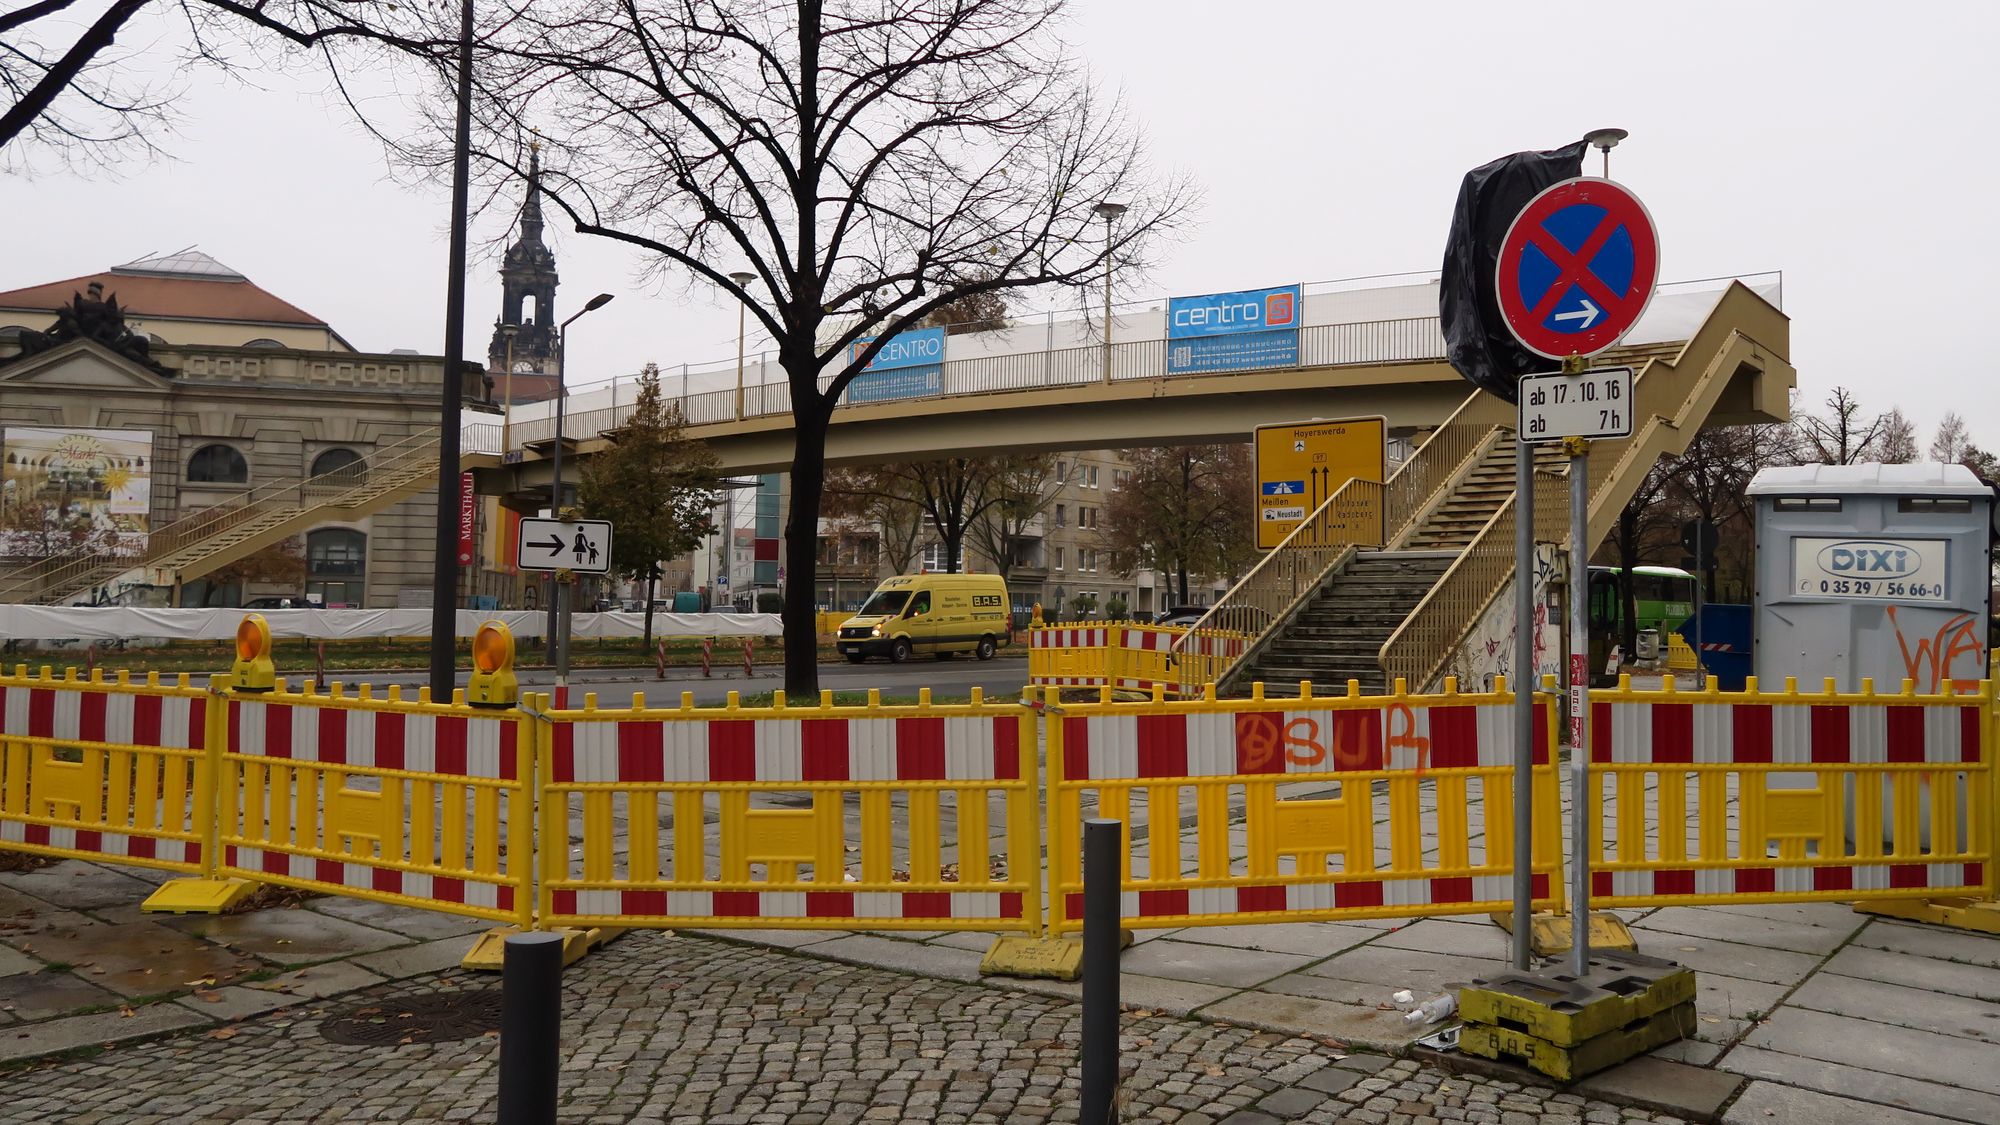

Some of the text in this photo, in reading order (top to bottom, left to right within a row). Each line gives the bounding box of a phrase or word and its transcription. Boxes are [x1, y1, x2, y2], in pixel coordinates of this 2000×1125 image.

[1175, 300, 1260, 327] centro
[879, 337, 940, 362] CENTRO
[1530, 387, 1545, 406] ab
[1605, 380, 1620, 400] 16
[1530, 409, 1620, 433] ab 7 h
[1294, 427, 1346, 438] Hoyerswerda
[1262, 498, 1289, 506] Meißen
[1277, 510, 1303, 518] Neustadt
[1820, 580, 1829, 593] 0
[1833, 580, 1850, 594] 35
[1854, 581, 1872, 595] 29
[1887, 582, 1905, 596] 56
[1909, 582, 1942, 597] 66-0
